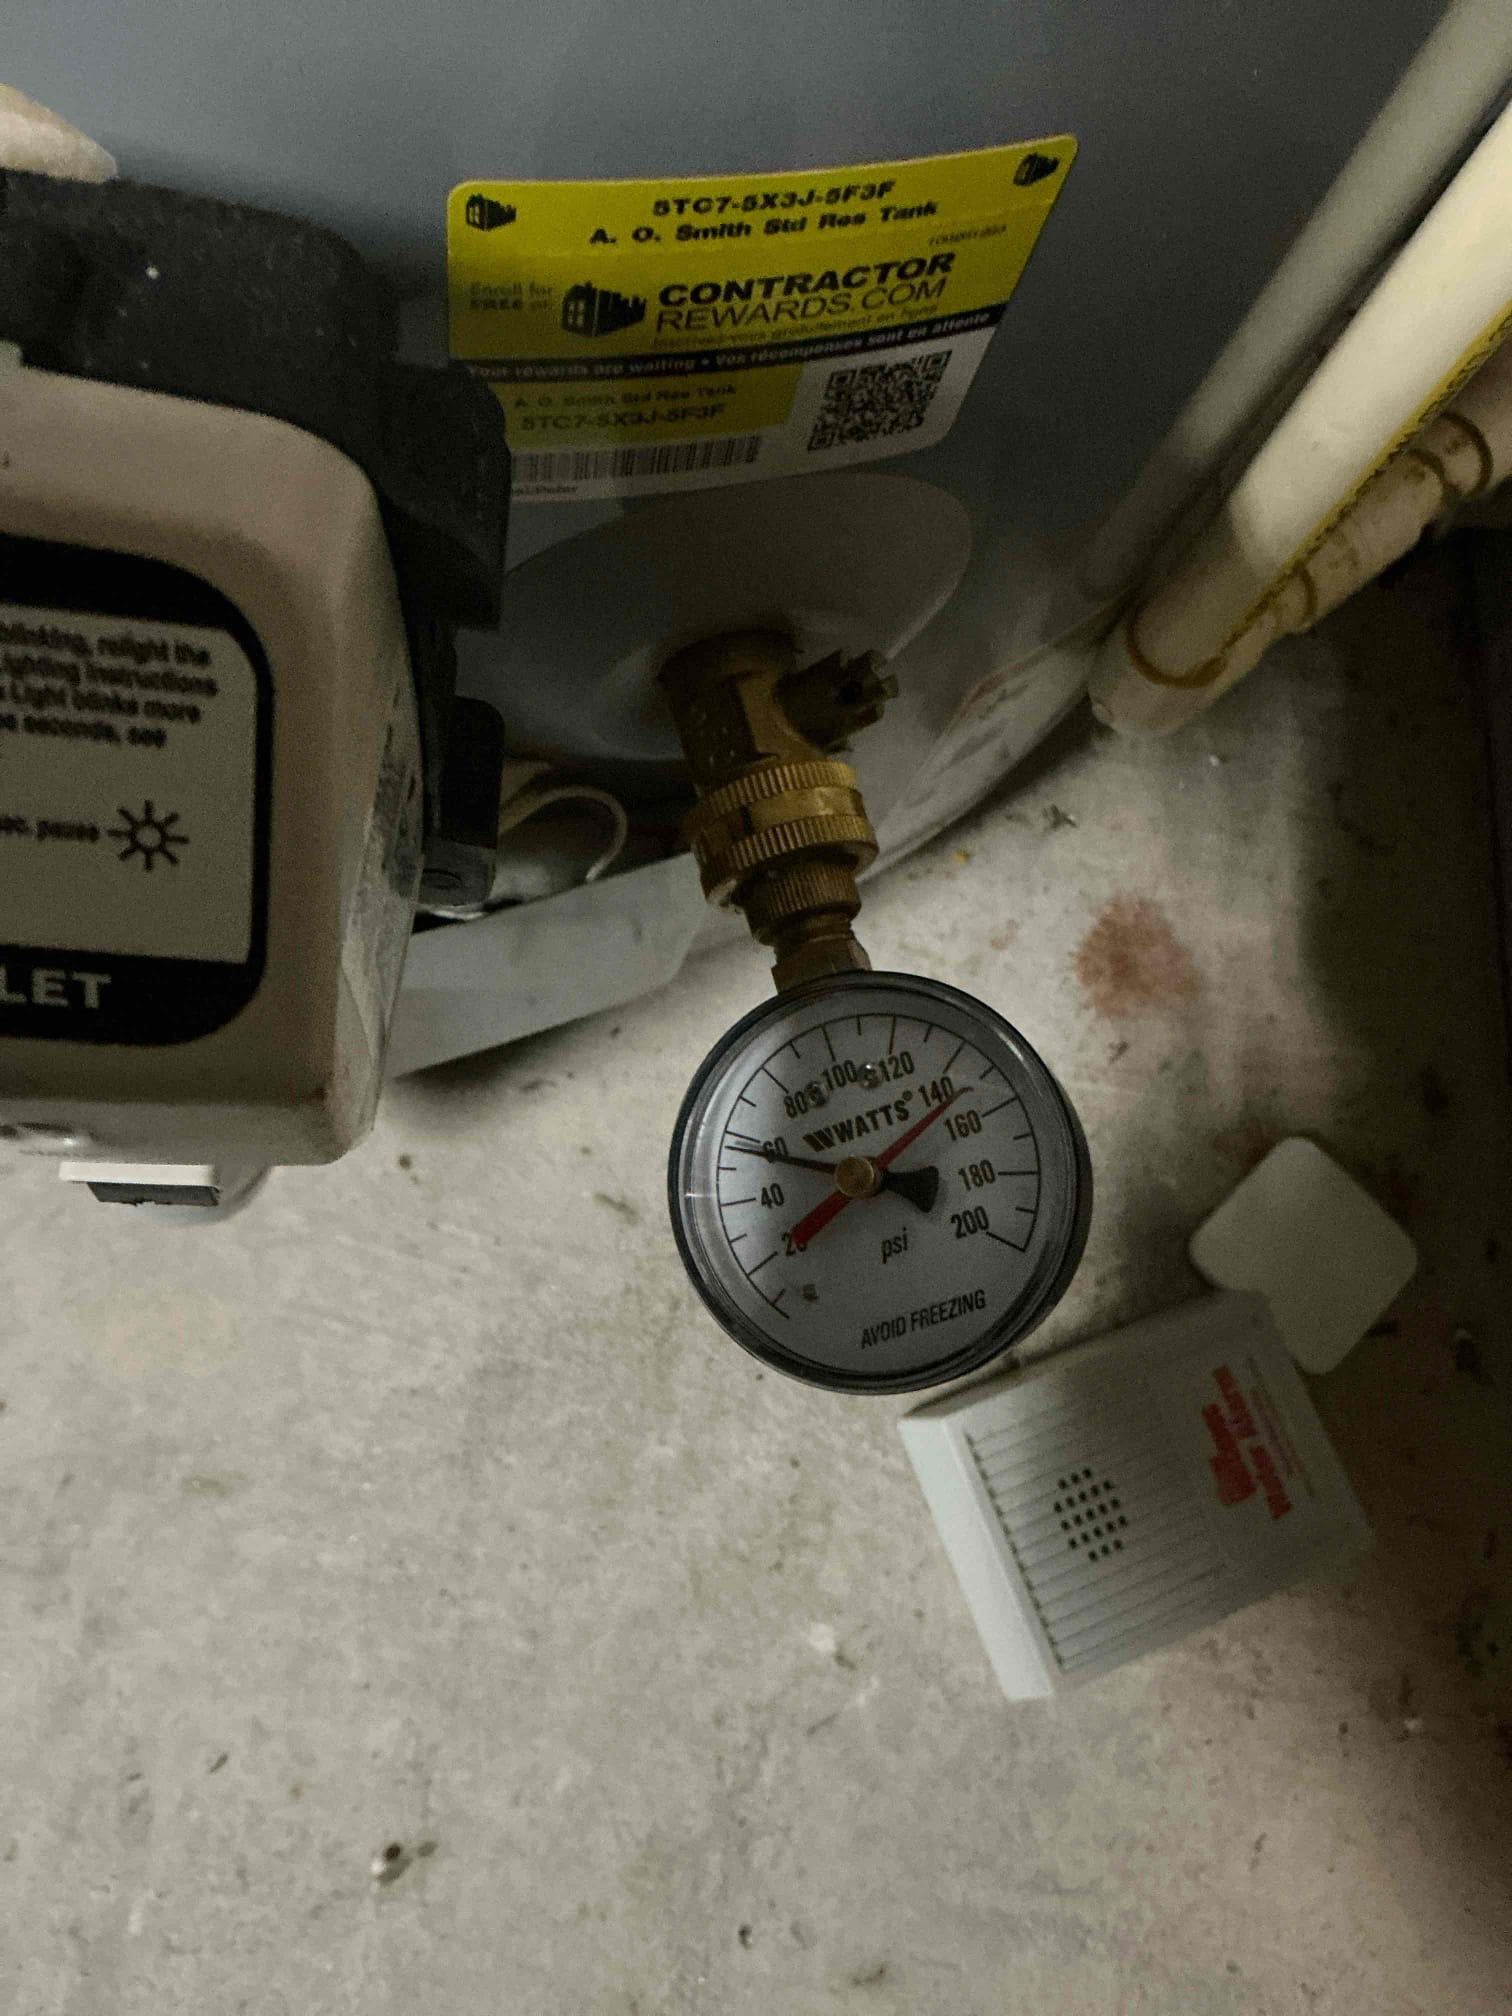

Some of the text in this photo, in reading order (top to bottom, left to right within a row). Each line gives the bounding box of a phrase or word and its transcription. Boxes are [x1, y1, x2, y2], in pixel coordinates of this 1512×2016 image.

[589, 228, 617, 245] A.
[631, 226, 661, 243] O.
[675, 221, 752, 241] Smith
[764, 216, 807, 235] Std
[880, 200, 938, 222] Tank
[658, 252, 955, 307] CONTRACTOR
[655, 277, 947, 334] REWARDS.COM
[594, 361, 624, 376] are
[629, 356, 696, 375] waiting
[866, 330, 904, 347] sont
[931, 312, 990, 335] attente
[823, 1058, 858, 1091] 100
[879, 1050, 915, 1081] 120
[784, 1090, 809, 1118] 80
[918, 1075, 955, 1109] 140
[944, 1109, 983, 1142] 160
[763, 1136, 788, 1163] 60
[957, 1158, 996, 1192] 180
[760, 1182, 785, 1210] 40
[950, 1205, 990, 1239] 200
[880, 1226, 909, 1264] psi
[860, 1288, 987, 1350] AVOID FREEZING
